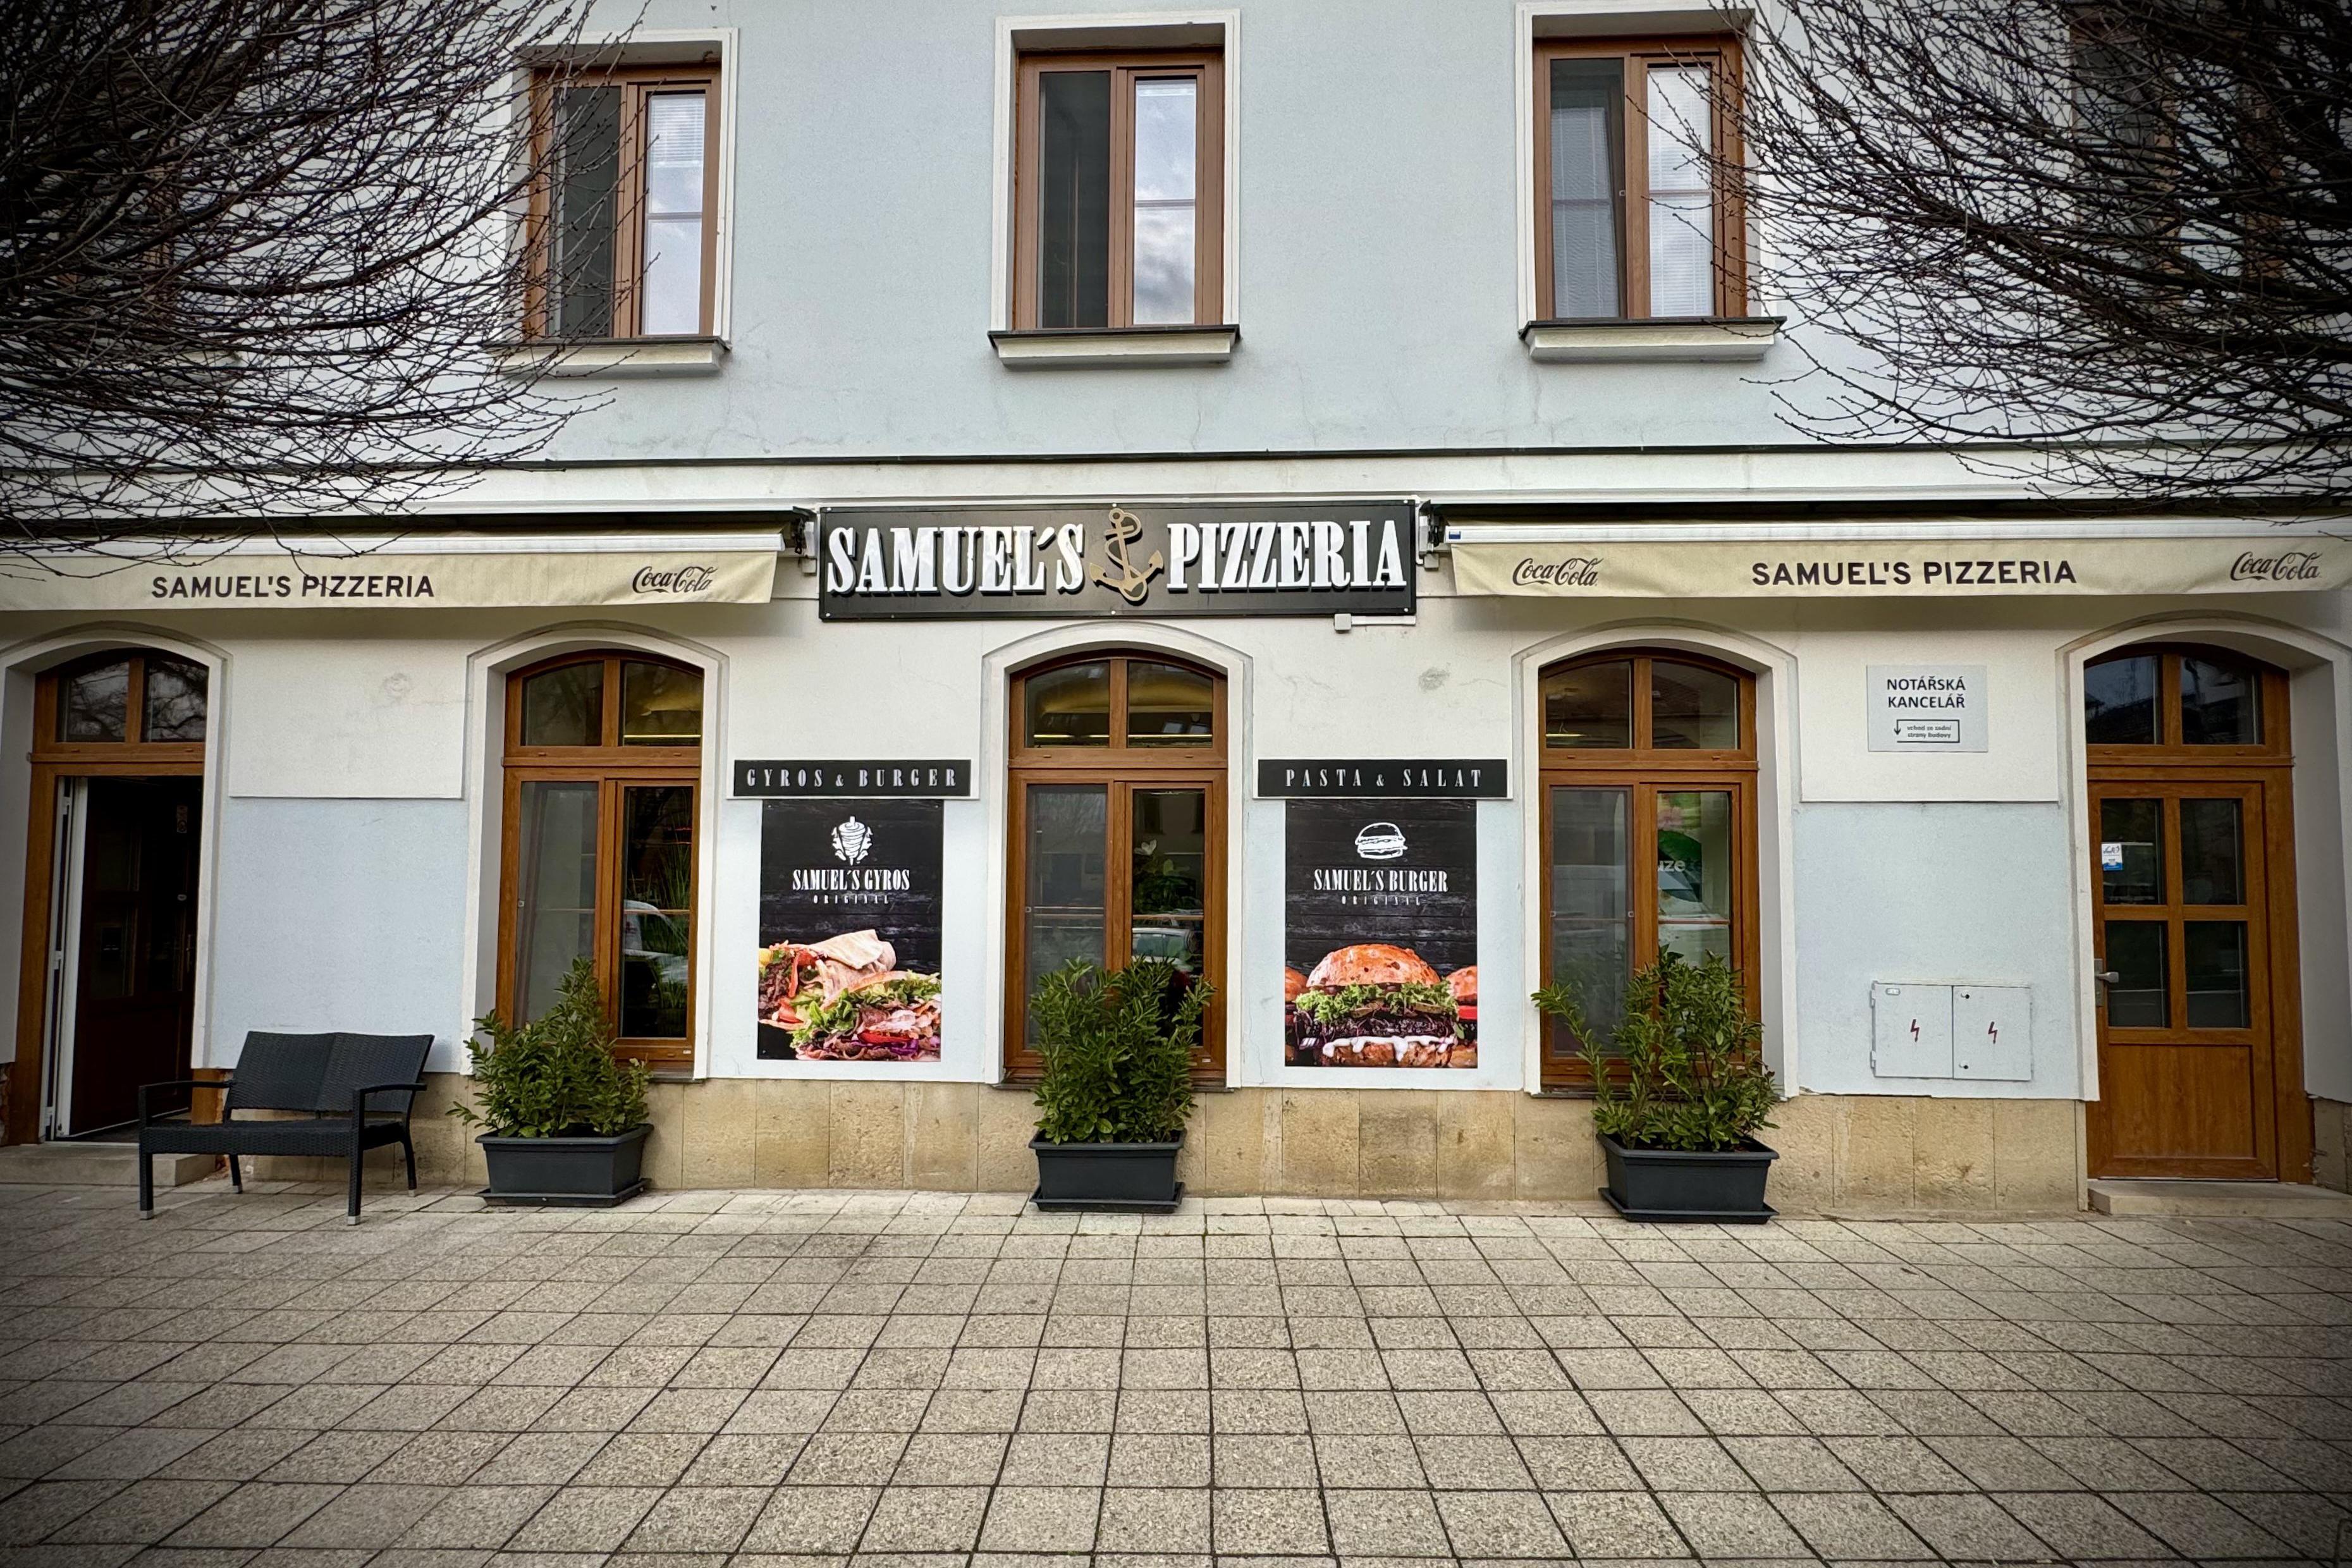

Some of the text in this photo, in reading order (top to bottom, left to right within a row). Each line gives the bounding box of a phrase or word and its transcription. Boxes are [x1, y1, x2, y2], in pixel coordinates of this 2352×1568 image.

[1166, 520, 1408, 591] PIZZERIA
[1752, 560, 2077, 585] SAMUEL'S PIZZERIA
[151, 575, 435, 598] SAMUEL'S PIZZERIA
[1887, 676, 1966, 690] NOTÁŘSKÁ
[1888, 694, 1965, 708] KANCELÁŘ
[747, 769, 956, 787] GYROS & BURGER
[1285, 769, 1481, 787] PASTA & SALAT
[864, 869, 910, 890] GYROS
[1389, 870, 1449, 892] BURGER
[813, 895, 889, 904] ORIGINAL
